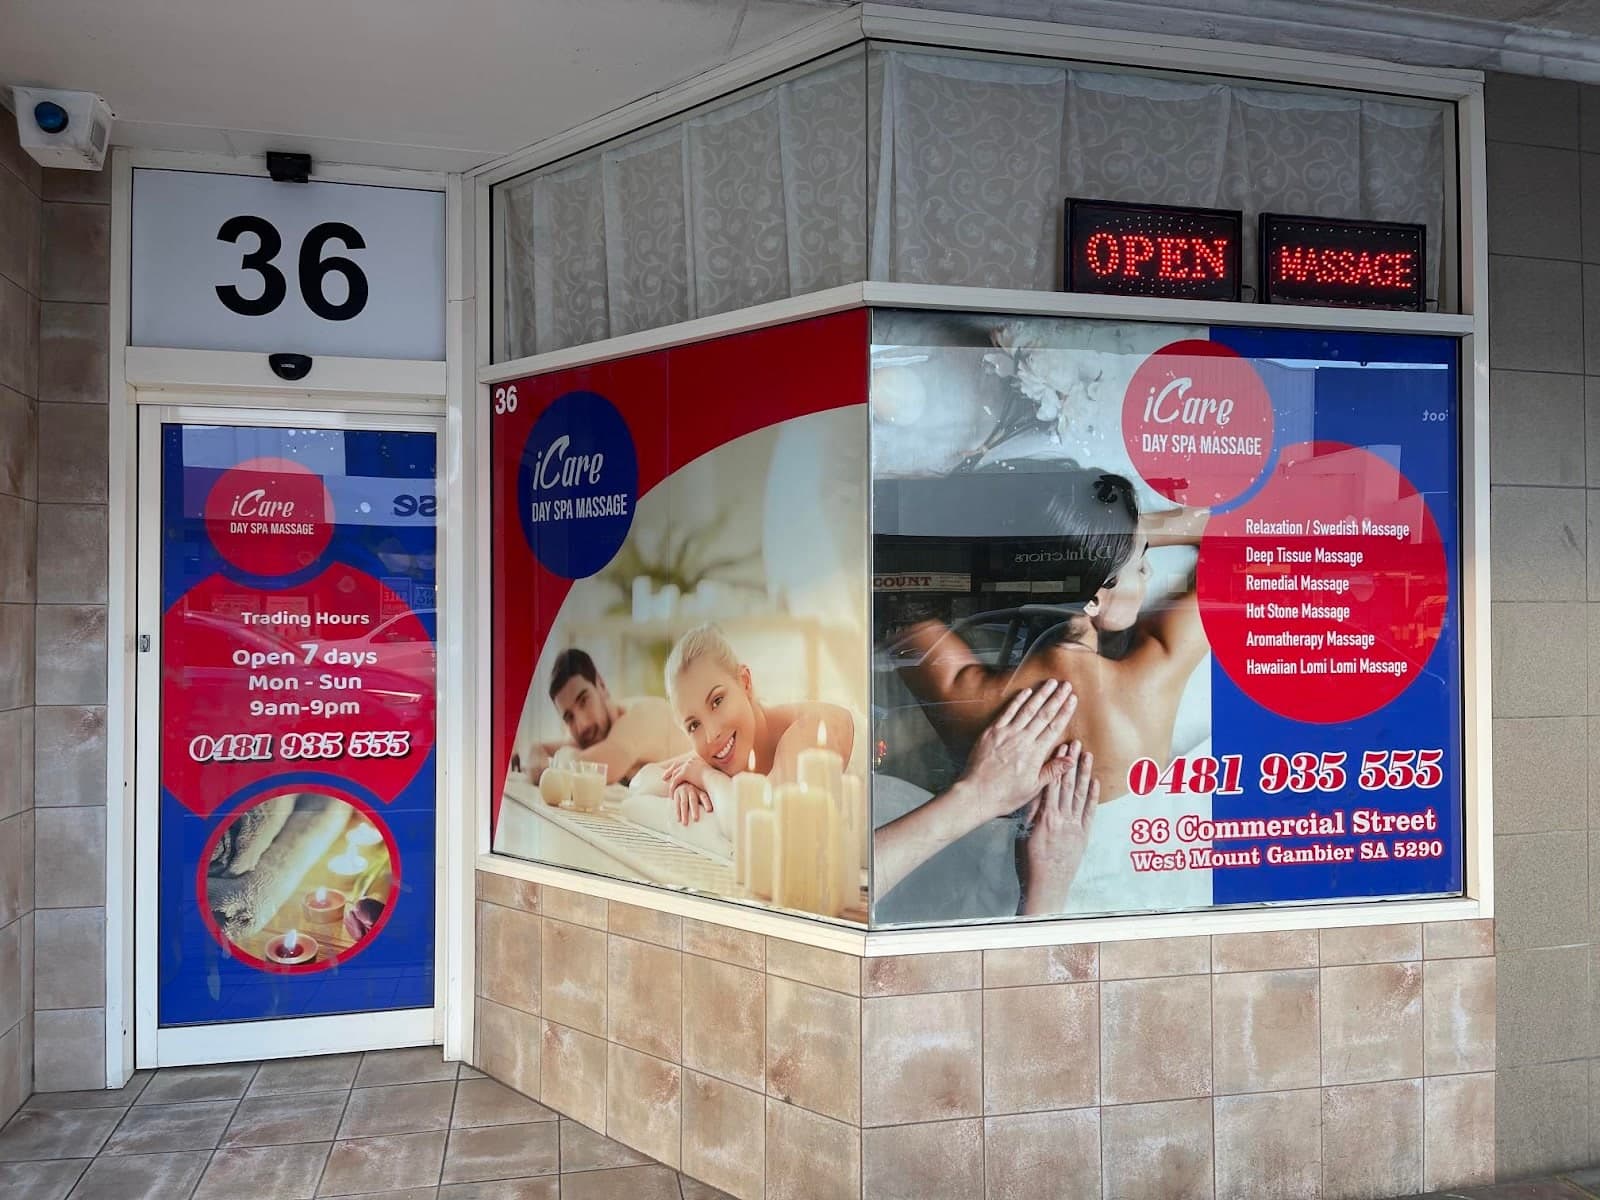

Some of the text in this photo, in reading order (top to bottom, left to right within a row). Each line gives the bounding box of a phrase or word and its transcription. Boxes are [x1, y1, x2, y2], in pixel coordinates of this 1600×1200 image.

[215, 215, 369, 321] 36
[1087, 233, 1228, 279] OPEN
[1279, 245, 1412, 288] MASSAGE
[495, 385, 518, 415] 36
[1143, 377, 1234, 425] iCare
[1143, 434, 1262, 456] DAY SPA MASSAGE
[532, 434, 604, 490] iCare
[231, 489, 295, 518] iCare
[532, 494, 628, 522] DAY SPA MASSAGE
[230, 522, 314, 535] DAY SPA MASSAGE
[1246, 519, 1302, 535] Relaxation
[1313, 520, 1359, 536] Swedish
[1362, 521, 1410, 539] Massage
[1246, 547, 1363, 567] Deep Tissue Massage
[1246, 575, 1349, 595] Remedial Massage
[241, 611, 370, 628] Trading Hours
[1246, 603, 1350, 622] Hot Stone Massage
[1246, 631, 1375, 650] Aromatherapy Massage
[233, 644, 377, 668] Open 7 days
[1246, 658, 1408, 676] Hawaiian Lomi Lomi Massage
[249, 675, 299, 690] Mon
[319, 675, 362, 690] Sun
[250, 700, 360, 718] 9am-9pm
[189, 731, 411, 762] 0481 935 555
[1127, 749, 1443, 796] 0481 935 555
[1131, 808, 1436, 844] 36 Commercial Street
[1131, 840, 1443, 872] West Mount Gambier SA 5290
